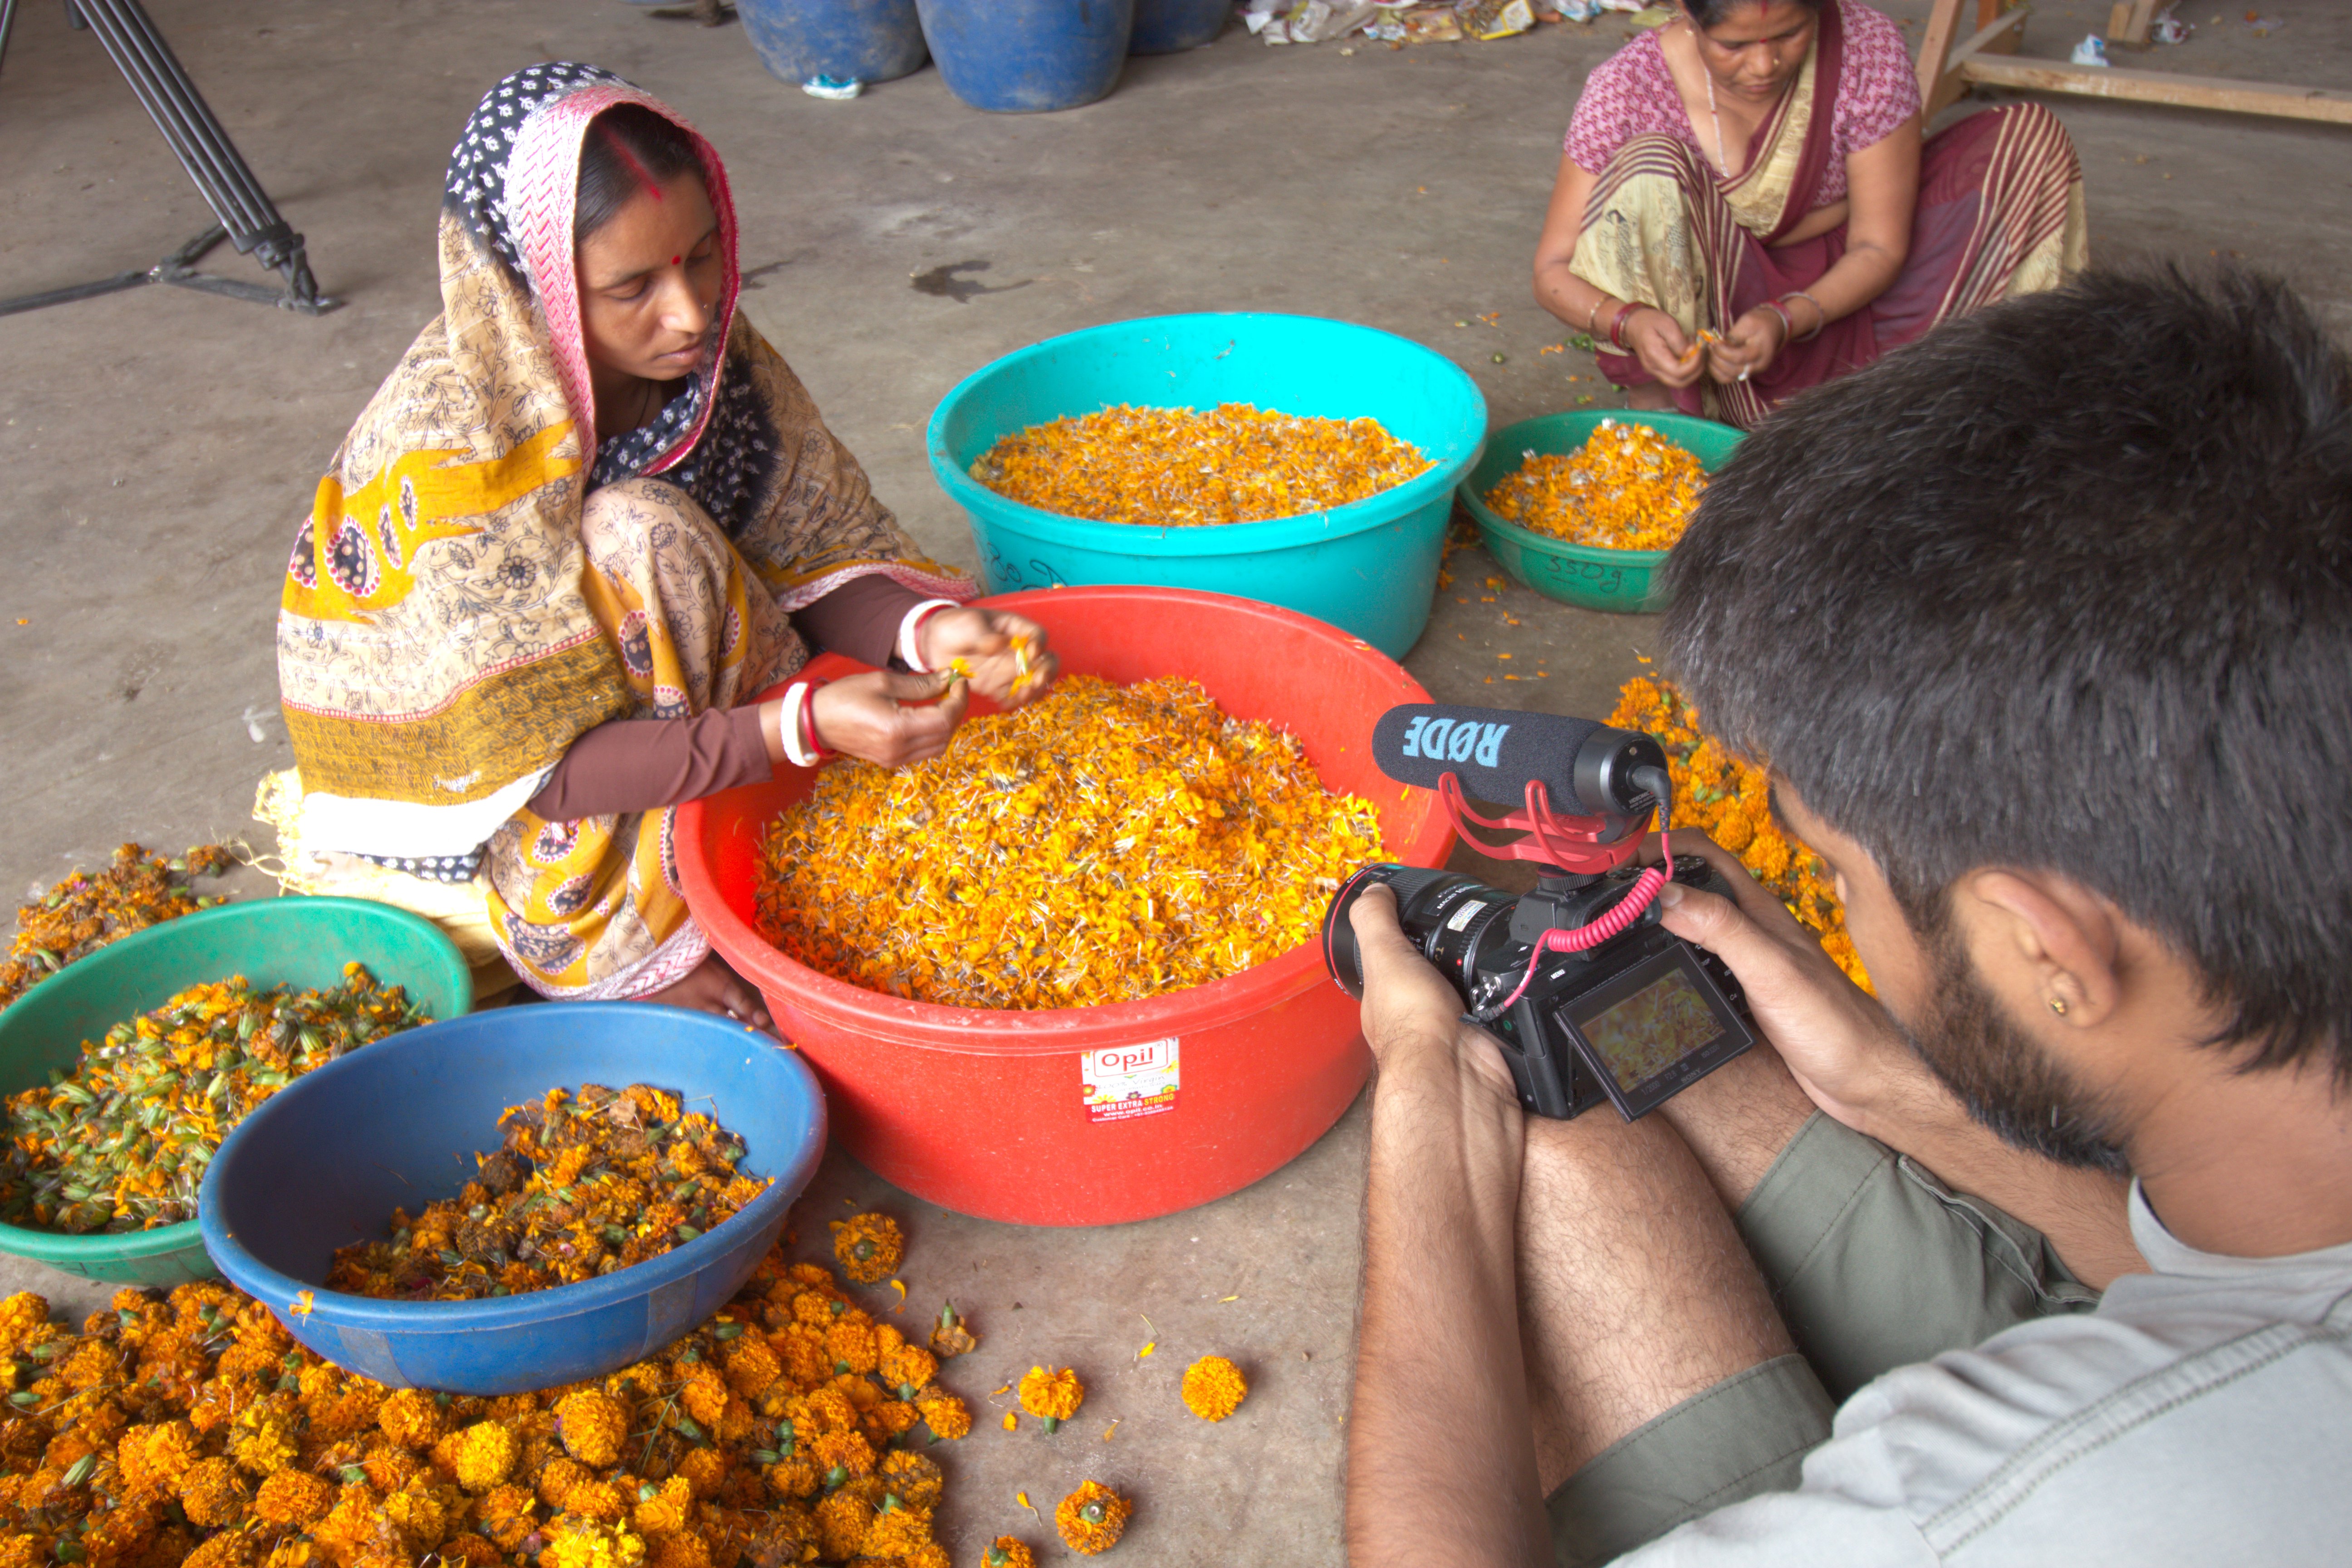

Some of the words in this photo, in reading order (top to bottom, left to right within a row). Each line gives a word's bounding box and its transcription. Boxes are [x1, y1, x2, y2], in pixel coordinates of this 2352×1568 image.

[1347, 868, 1365, 883] CANON
[1437, 893, 1457, 909] MACRO
[1550, 969, 1566, 980] MENU
[1101, 1047, 1153, 1071] Opil
[1681, 1068, 1701, 1083] SONY
[1091, 1103, 1116, 1113] SUPER
[1117, 1100, 1143, 1110] EXTRA
[1144, 1093, 1175, 1106] STRONG
[1103, 1104, 1163, 1117] www.opil.co.in
